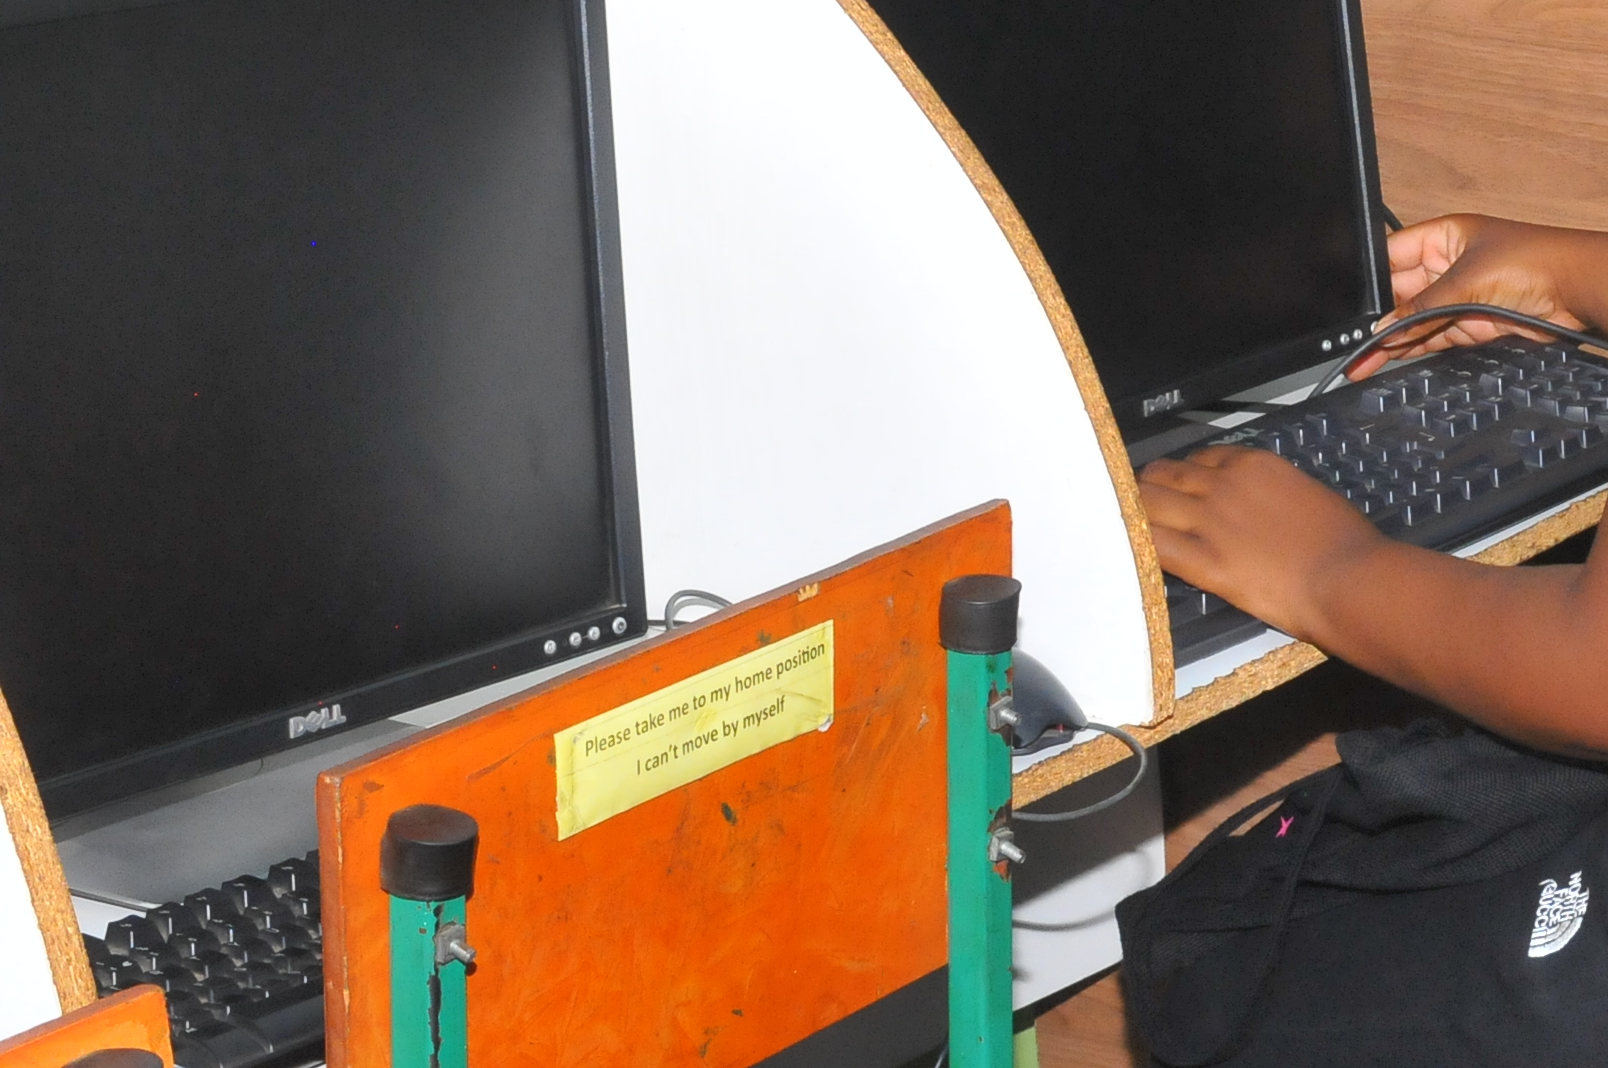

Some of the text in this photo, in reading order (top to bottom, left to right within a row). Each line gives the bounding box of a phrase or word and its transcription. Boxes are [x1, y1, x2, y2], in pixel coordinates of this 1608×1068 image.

[1143, 389, 1184, 417] DELL
[585, 643, 825, 757] Please take me to my home position
[289, 703, 347, 739] DELL
[636, 760, 641, 775] I
[682, 732, 719, 755] move
[722, 718, 739, 739] by
[743, 695, 786, 729] myself
[1549, 888, 1569, 927] FACE
[1560, 870, 1582, 922] NORTH
[1576, 887, 1590, 915] THE
